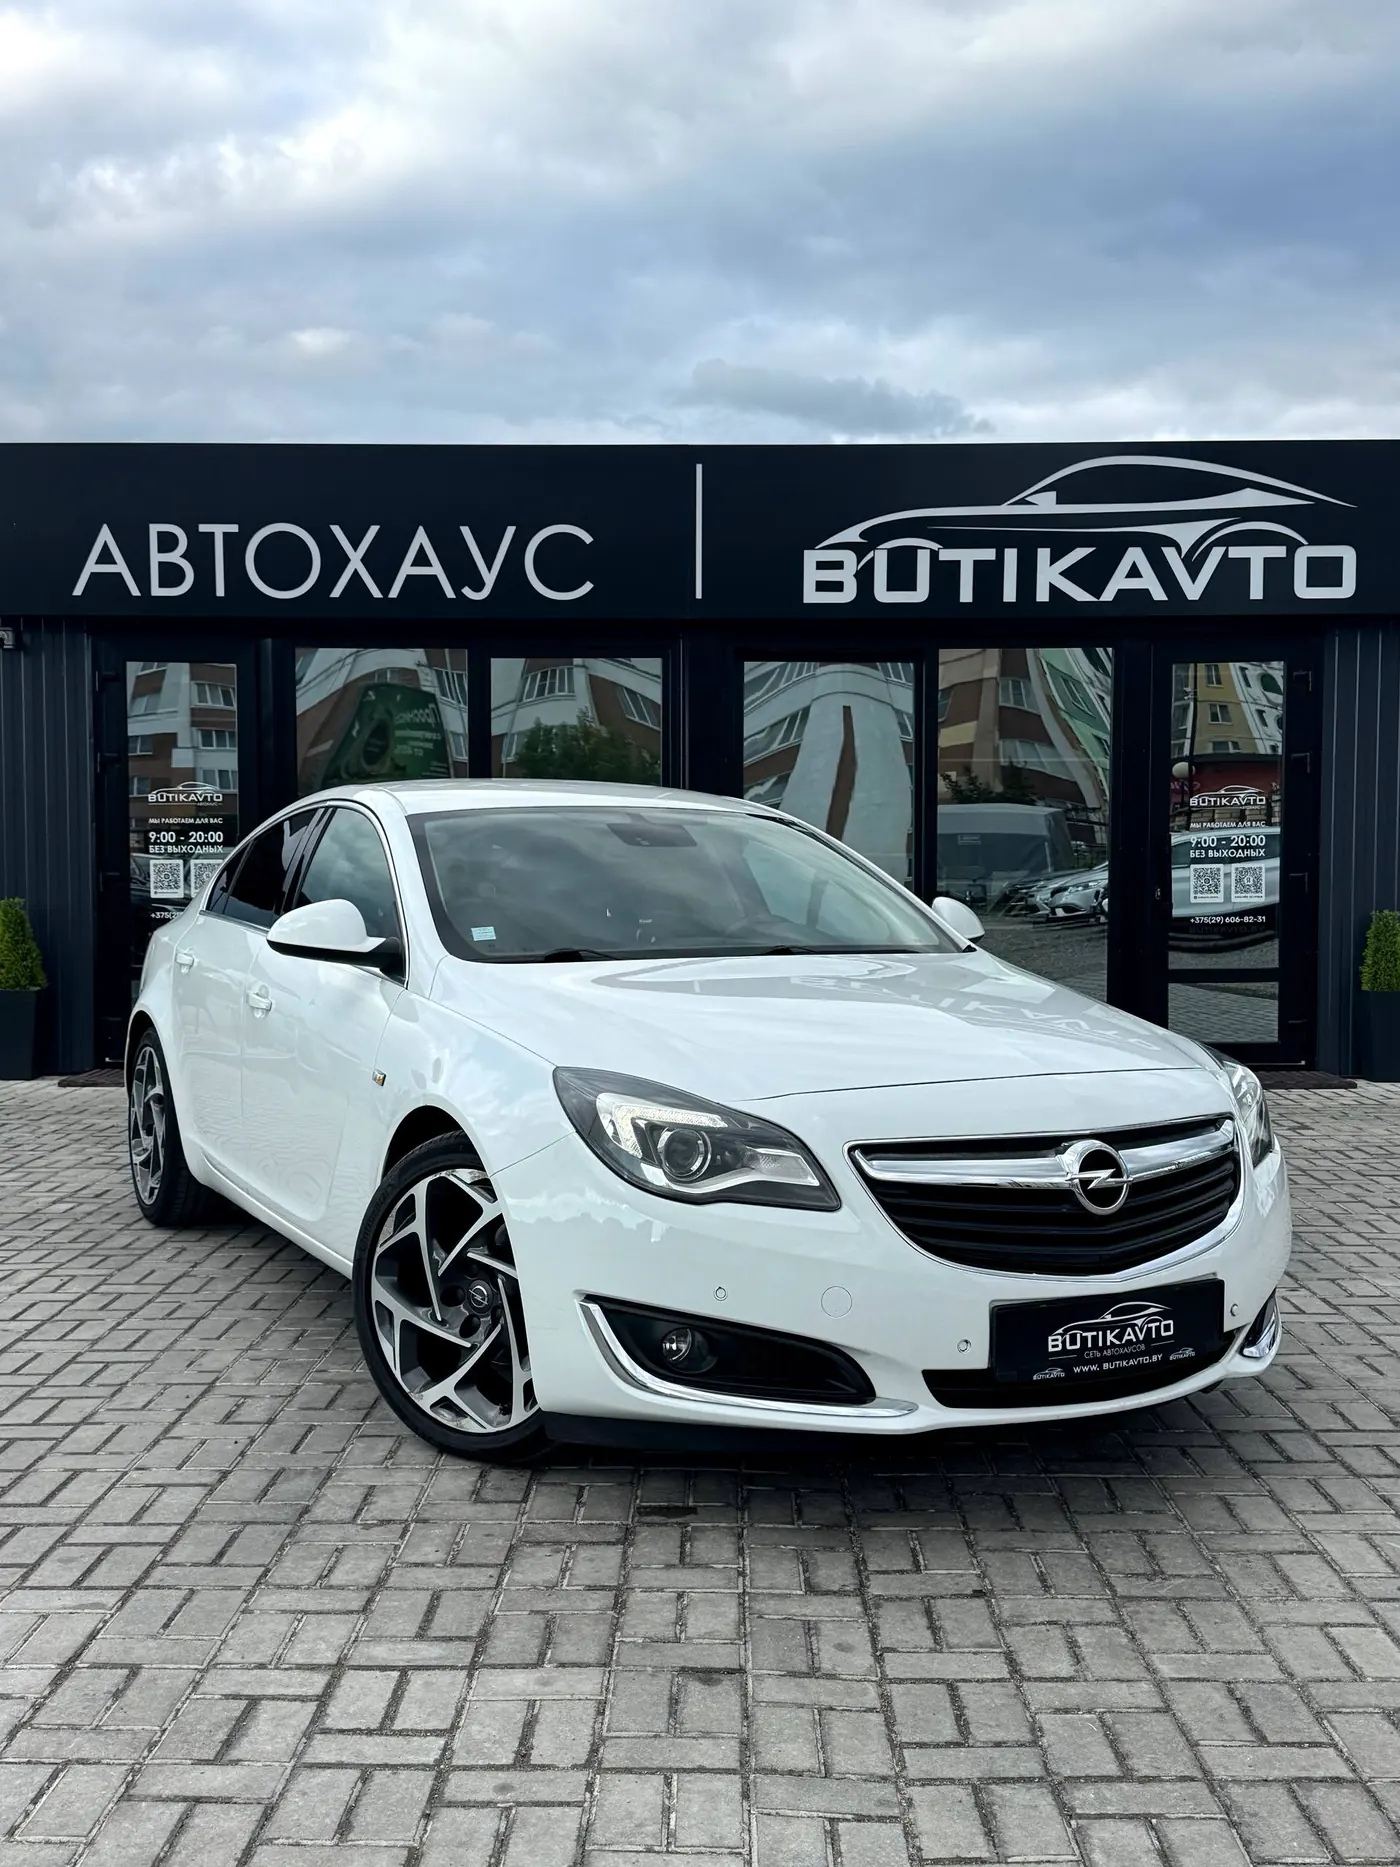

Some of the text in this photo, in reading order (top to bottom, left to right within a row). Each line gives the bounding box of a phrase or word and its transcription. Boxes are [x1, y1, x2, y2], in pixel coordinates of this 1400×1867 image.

[72, 522, 595, 602] АВТОХАУС
[802, 544, 1357, 605] BUTIKAVTO
[148, 793, 223, 802] BUTIKAVTO
[1189, 796, 1266, 806] BUTIKAVTO
[149, 832, 176, 843] 9:00
[188, 831, 223, 843] 20:00
[1190, 836, 1217, 847] 9:00
[1230, 835, 1266, 847] 20:00
[148, 845, 224, 854] БЕЗ ВЫХОДНЫХ
[1189, 849, 1266, 858] БЕЗ ВЫХОДНЫХ
[1190, 916, 1266, 924] +375(29) 606-82-31
[1048, 1319, 1174, 1353] BUTIKAVTO
[1084, 1343, 1145, 1359] СЕТЬ АВТОХАУСОВ
[1102, 1353, 1163, 1370] BUTIKAVTO.BY
[1032, 1371, 1066, 1381] BUTIKAVTO
